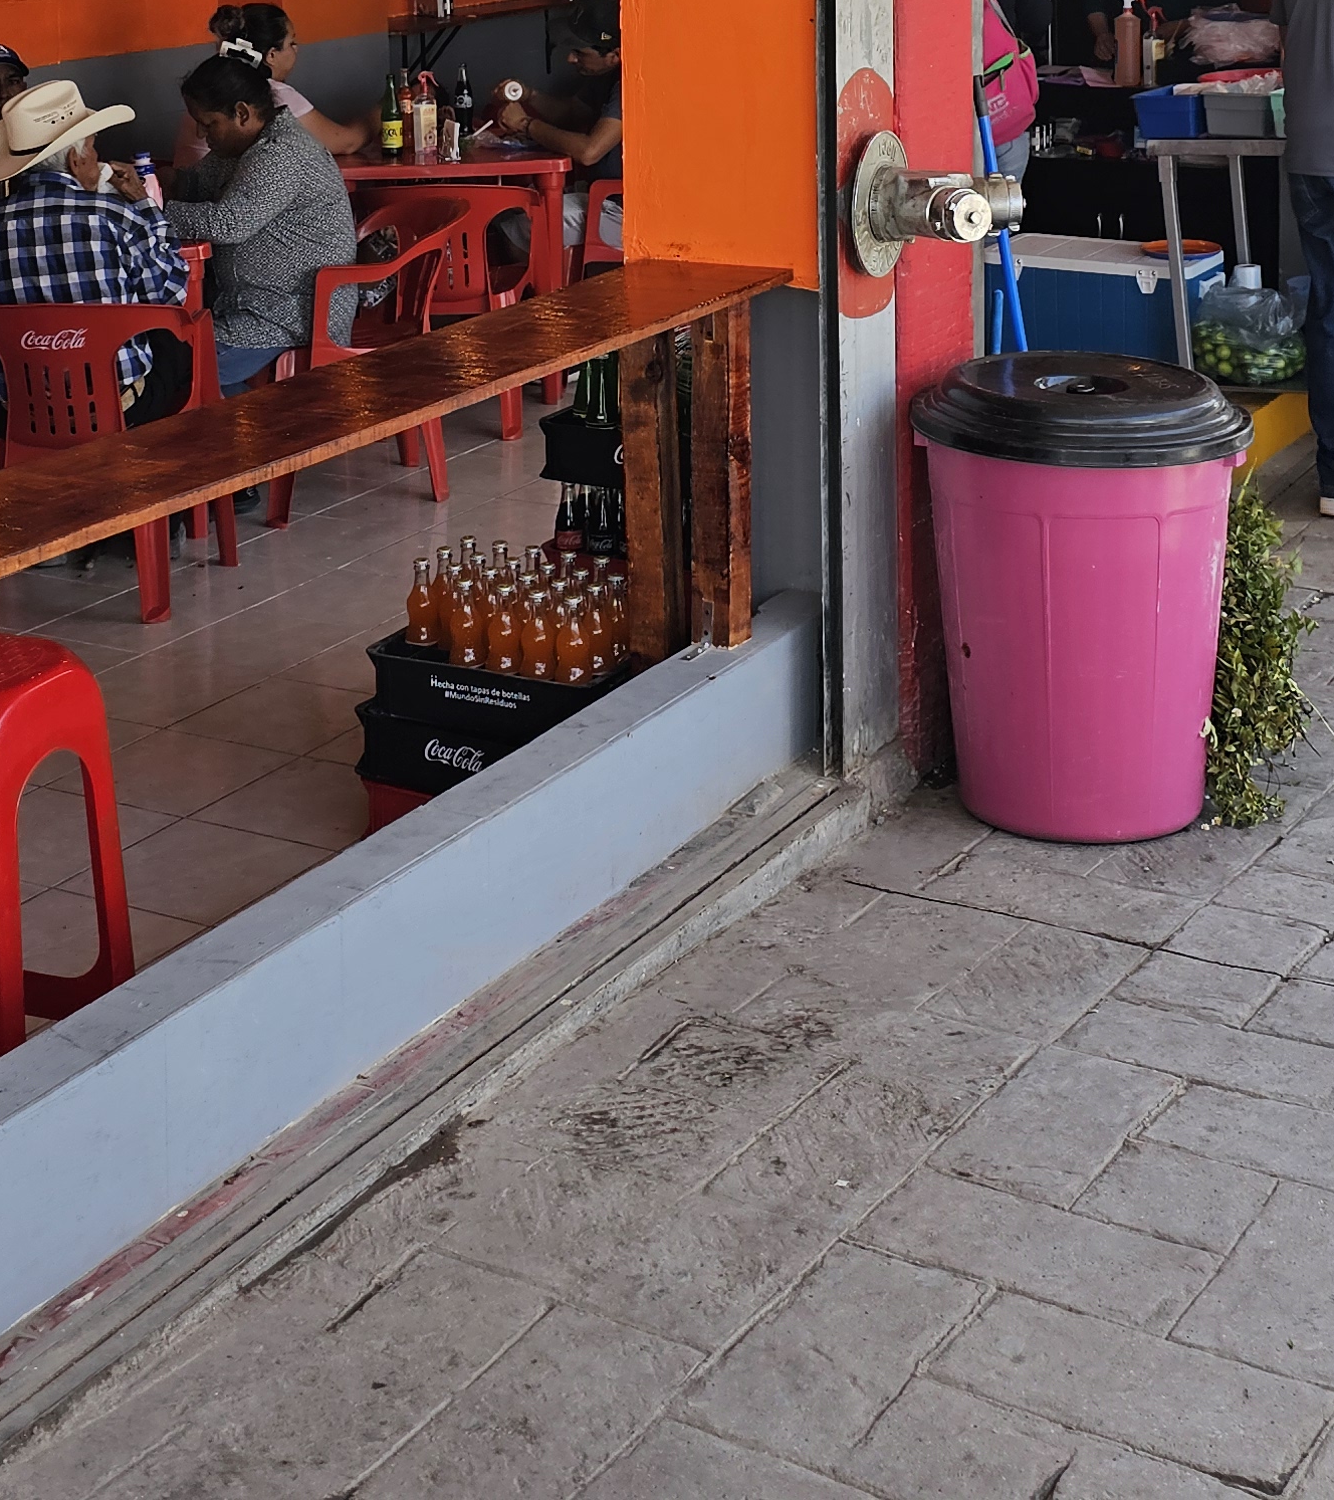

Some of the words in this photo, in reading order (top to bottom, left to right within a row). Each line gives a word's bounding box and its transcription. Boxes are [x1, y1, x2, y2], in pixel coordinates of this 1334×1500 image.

[20, 328, 89, 350] Coca-Cola
[430, 674, 455, 690] Hecha
[456, 683, 470, 692] con
[470, 685, 490, 696] tapas
[490, 687, 501, 697] de
[501, 689, 531, 702] botellas
[424, 738, 485, 773] Coca-Cola
